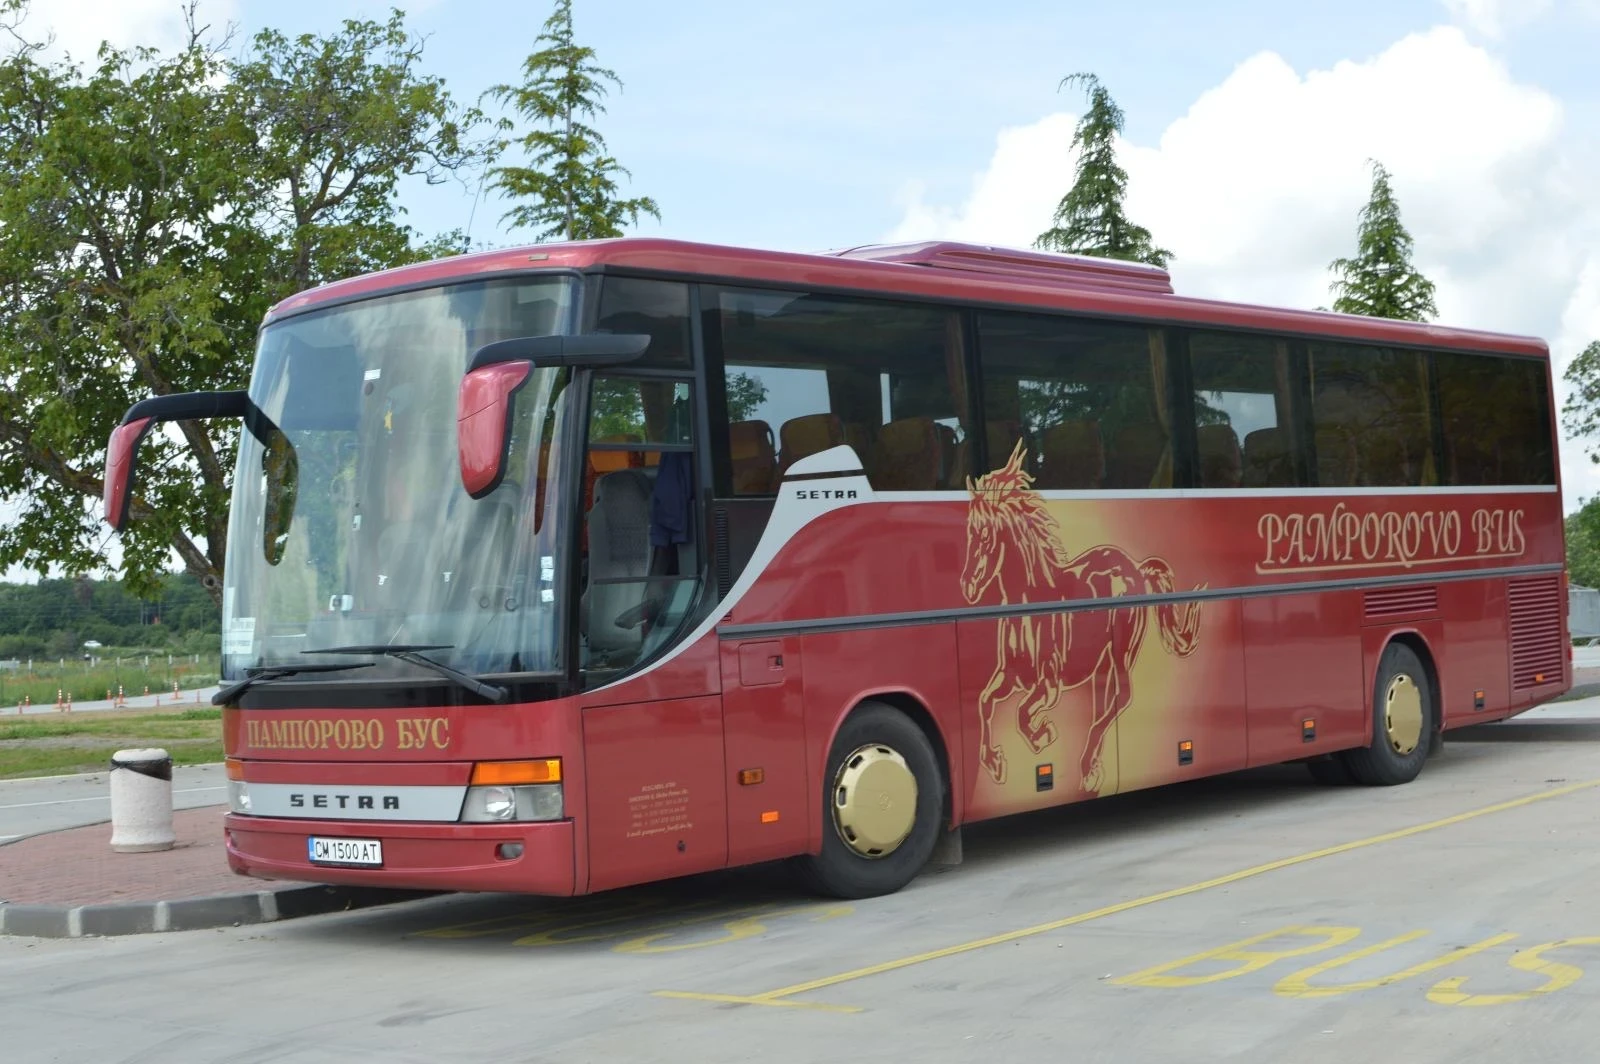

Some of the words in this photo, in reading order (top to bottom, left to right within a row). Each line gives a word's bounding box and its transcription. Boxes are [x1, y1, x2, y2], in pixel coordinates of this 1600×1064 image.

[796, 490, 857, 499] SETRA
[1257, 502, 1462, 567] PAMPOROVO
[1471, 509, 1526, 555] BUS
[246, 719, 385, 749] ПАМПОРОВО
[396, 718, 450, 749] БУС
[290, 794, 400, 810] SETRA
[332, 842, 360, 860] 1500
[1108, 925, 1600, 1006] BUS
